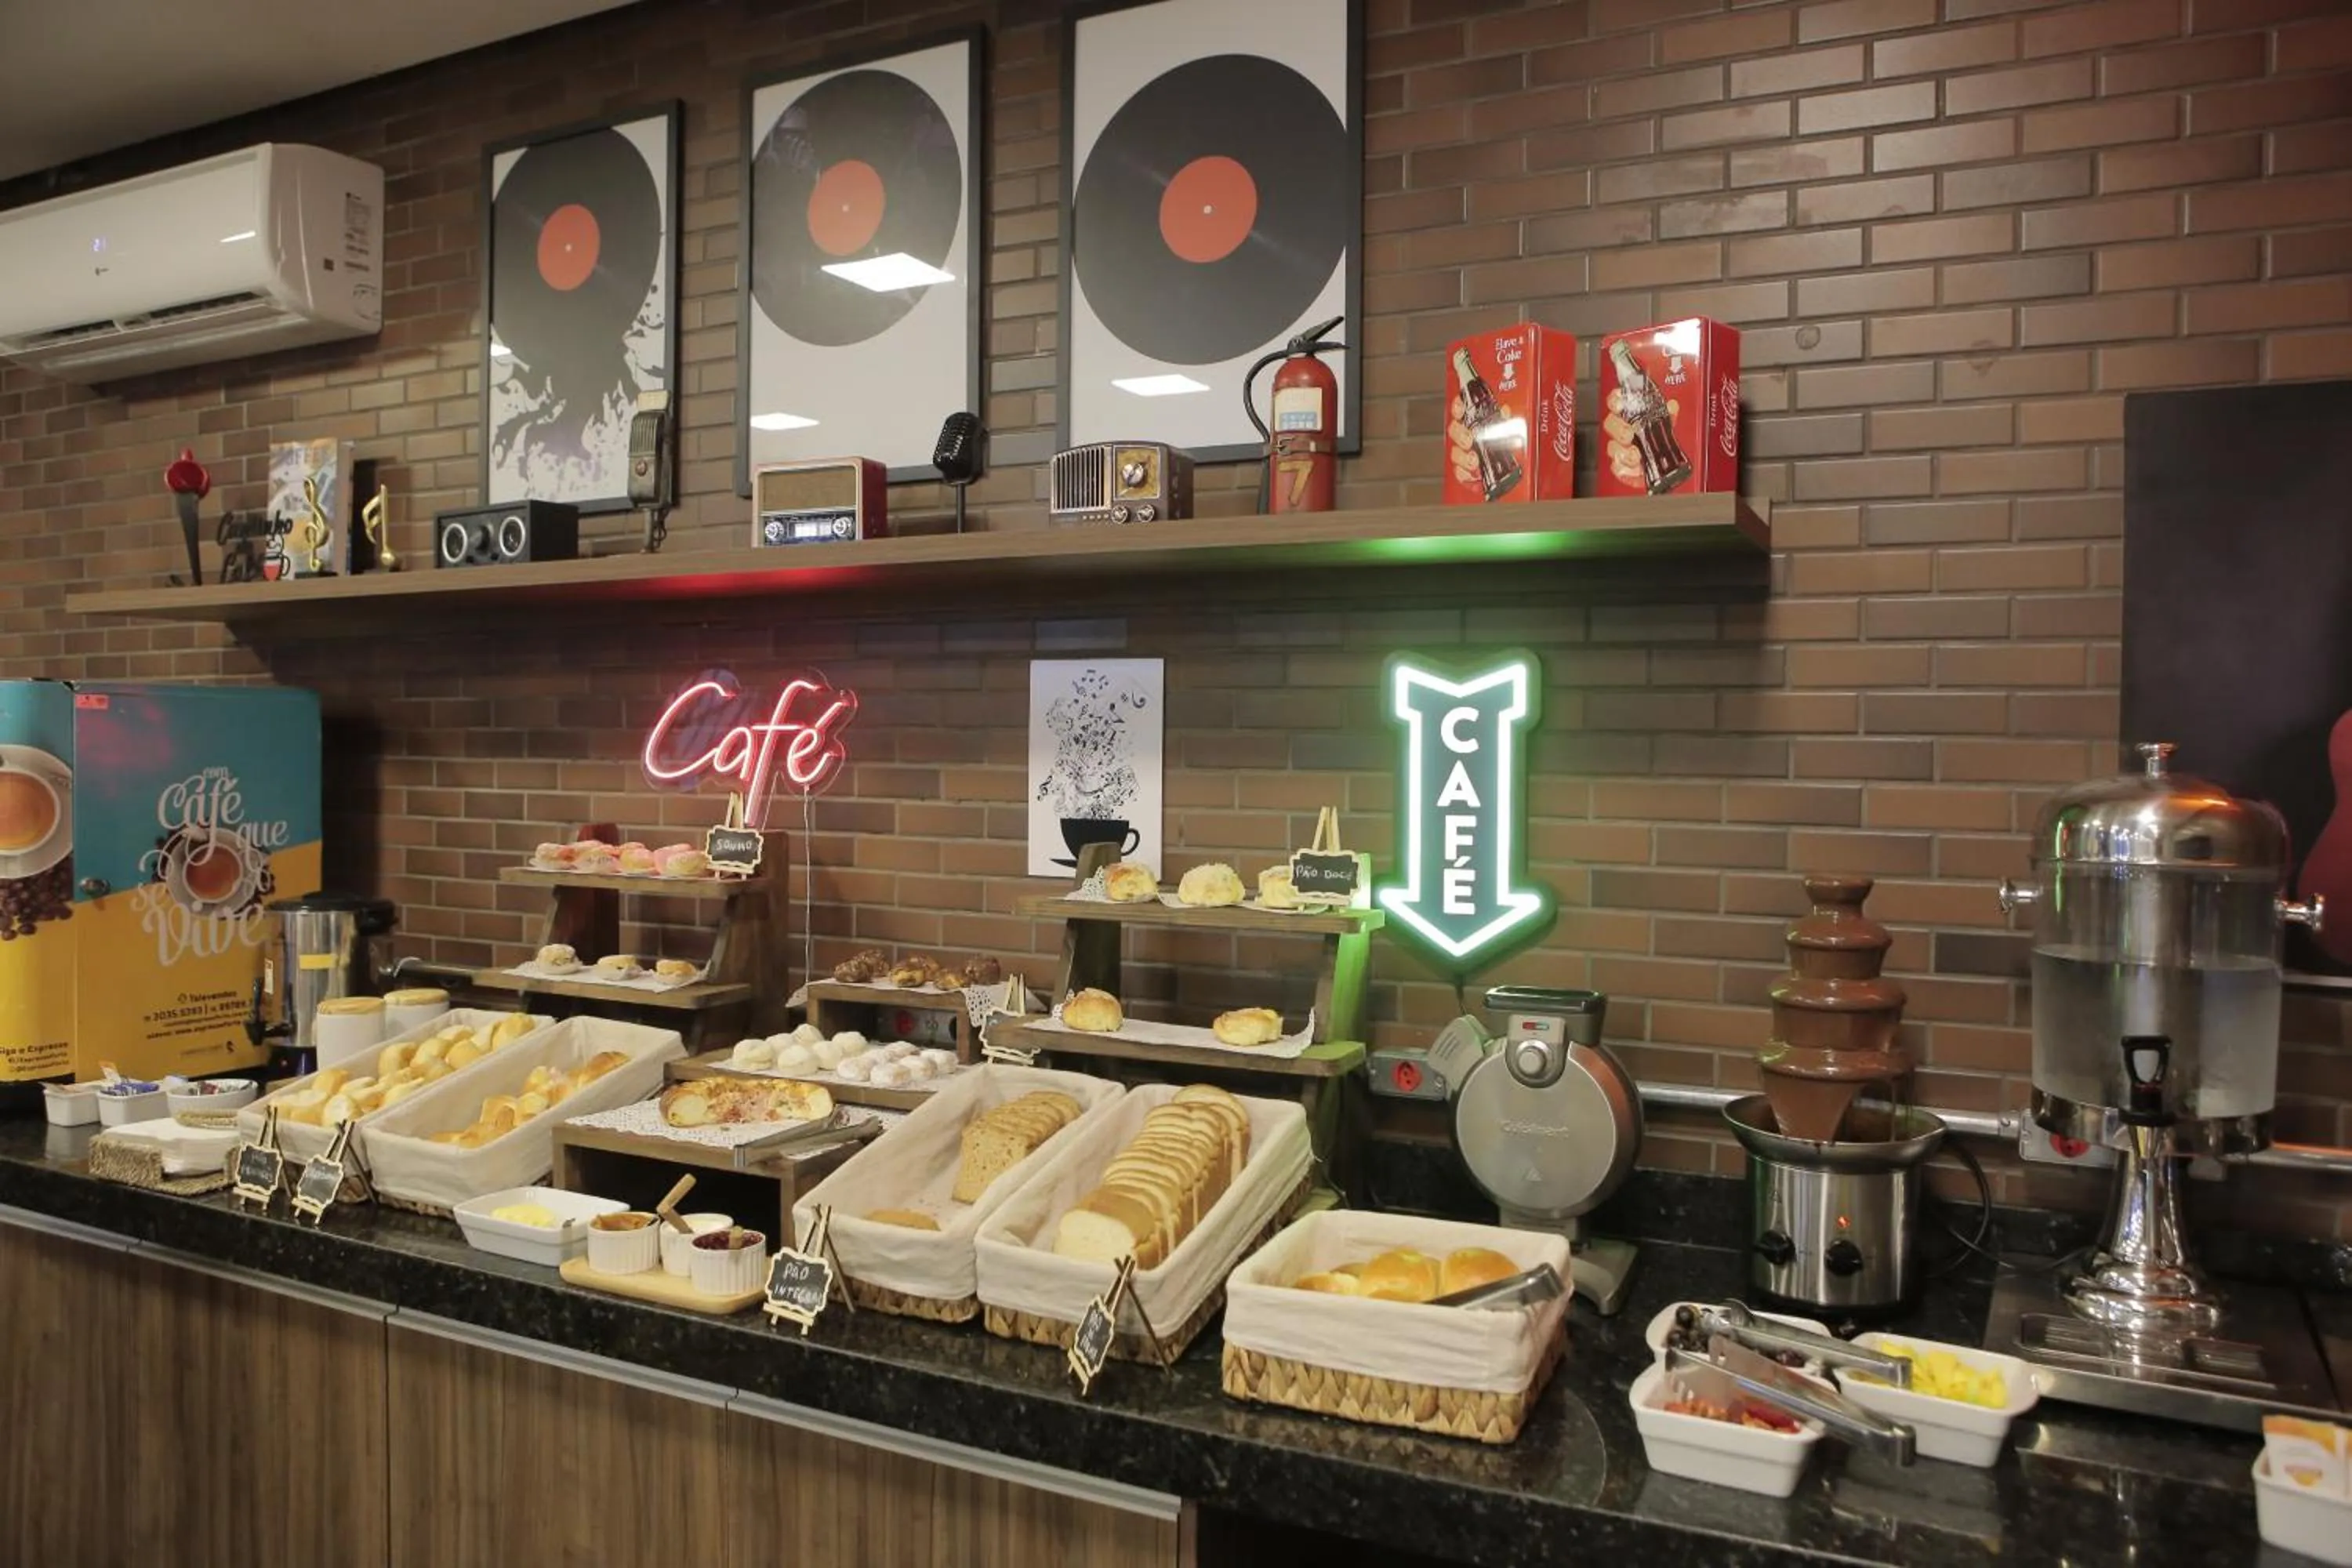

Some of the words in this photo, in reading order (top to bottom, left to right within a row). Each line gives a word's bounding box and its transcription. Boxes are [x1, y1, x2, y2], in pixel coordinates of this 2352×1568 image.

[1497, 350, 1523, 364] Coke
[1540, 399, 1549, 434] Drink
[1278, 460, 1315, 506] 7
[645, 679, 849, 826] Café
[158, 775, 245, 866] Café
[1436, 706, 1481, 915] CAFÉ
